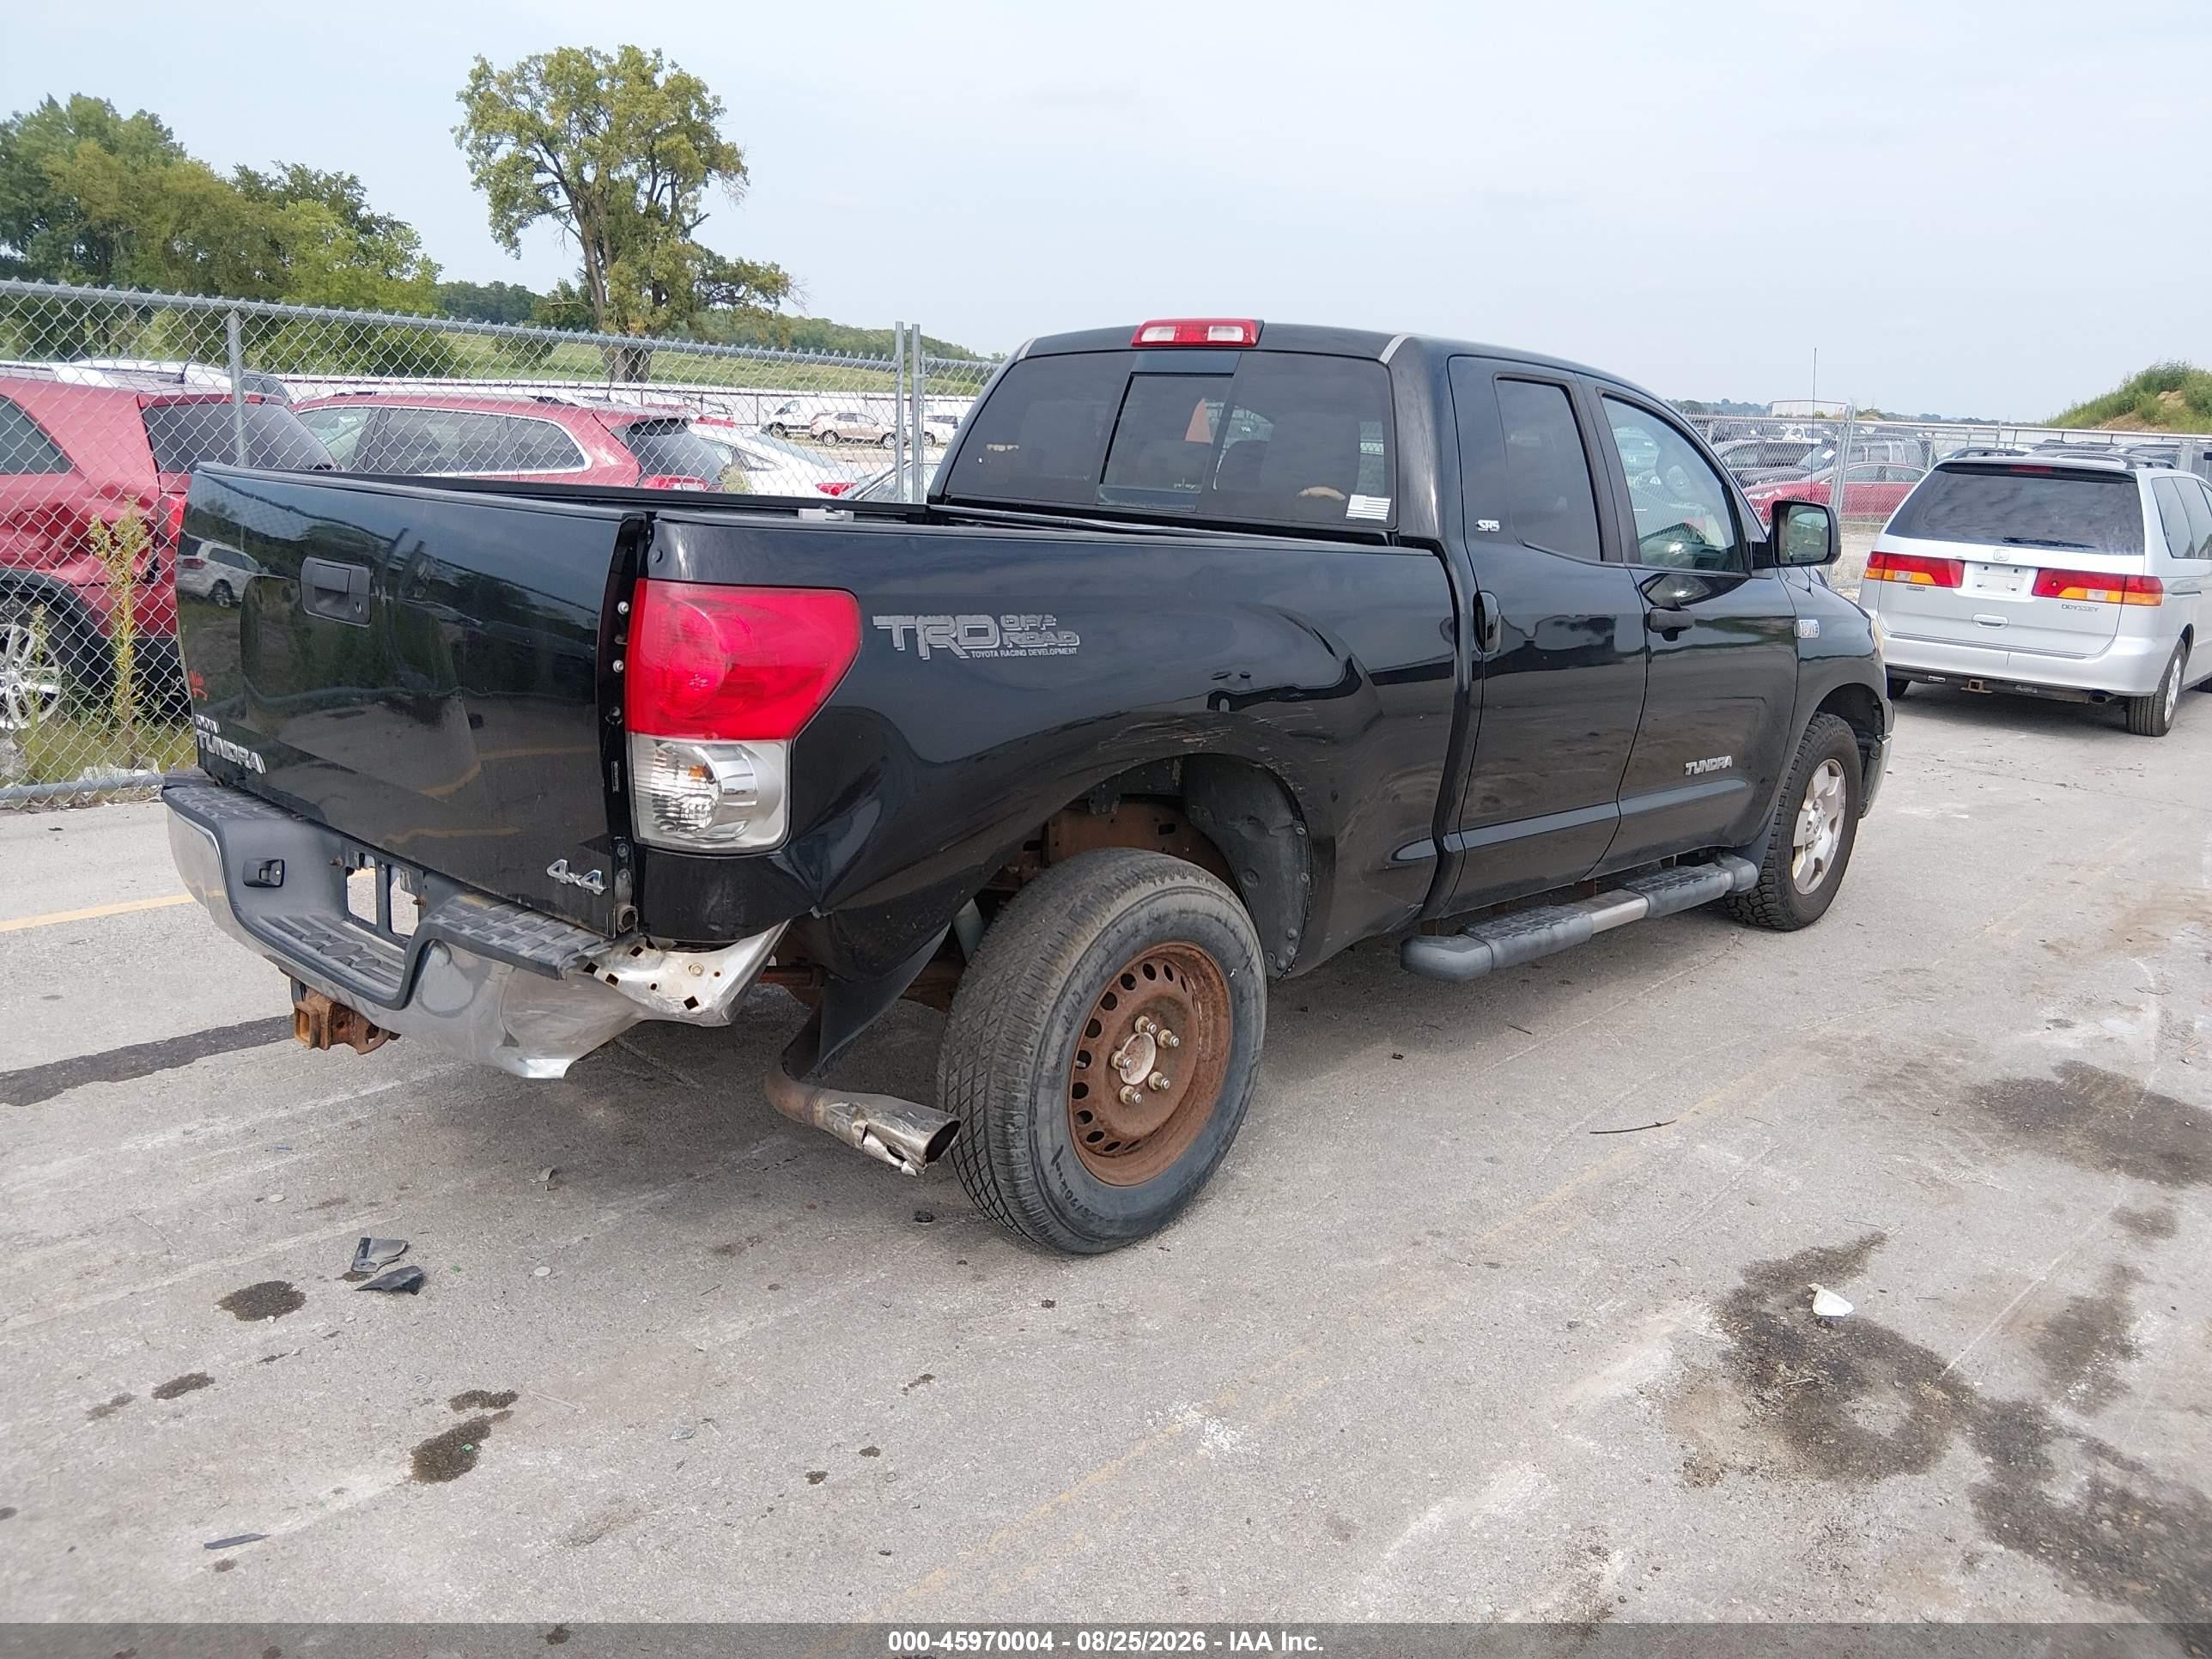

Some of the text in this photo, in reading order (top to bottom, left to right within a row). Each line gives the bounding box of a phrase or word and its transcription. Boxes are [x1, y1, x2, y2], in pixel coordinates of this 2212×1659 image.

[1000, 614, 1057, 631] OFF
[872, 615, 1000, 660] TRD
[1002, 630, 1080, 648] ROAD
[971, 647, 1078, 659] TOYOTA RACING DEVELOPMENT
[196, 728, 267, 774] TUNDRA
[1685, 755, 1733, 776] TUNDRA
